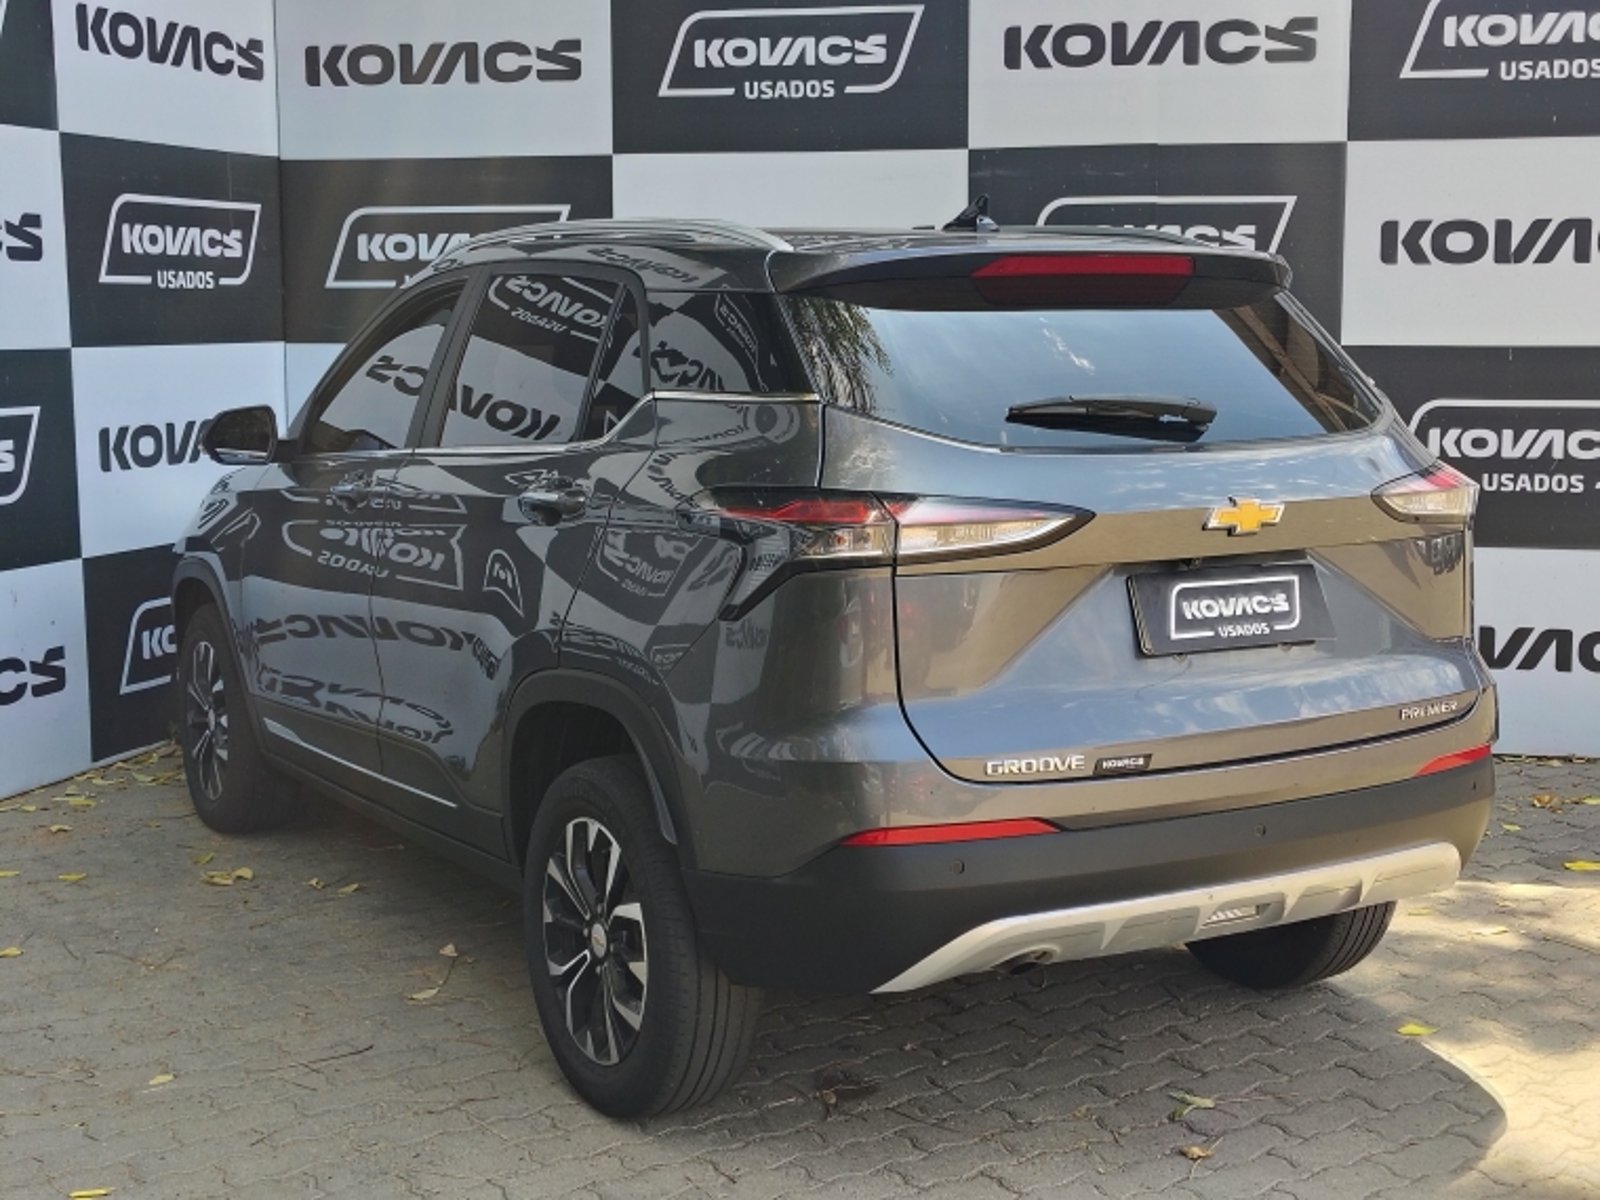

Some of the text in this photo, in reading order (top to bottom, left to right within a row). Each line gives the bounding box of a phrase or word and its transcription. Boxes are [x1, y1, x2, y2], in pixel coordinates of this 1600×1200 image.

[75, 3, 264, 81] KOVACS
[1003, 16, 1318, 70] KOVACS
[1443, 11, 1600, 47] KOVA
[304, 38, 582, 87] KOVACS
[694, 34, 887, 68] KOVACS
[744, 79, 835, 99] USADOS
[120, 223, 243, 258] KOVACS
[1379, 217, 1600, 266] KOVA
[157, 270, 214, 289] USADOS
[1481, 473, 1585, 493] USADOS
[1183, 593, 1290, 620] KOVACS
[1218, 622, 1271, 638] USADOS
[985, 755, 1085, 776] GROOVE
